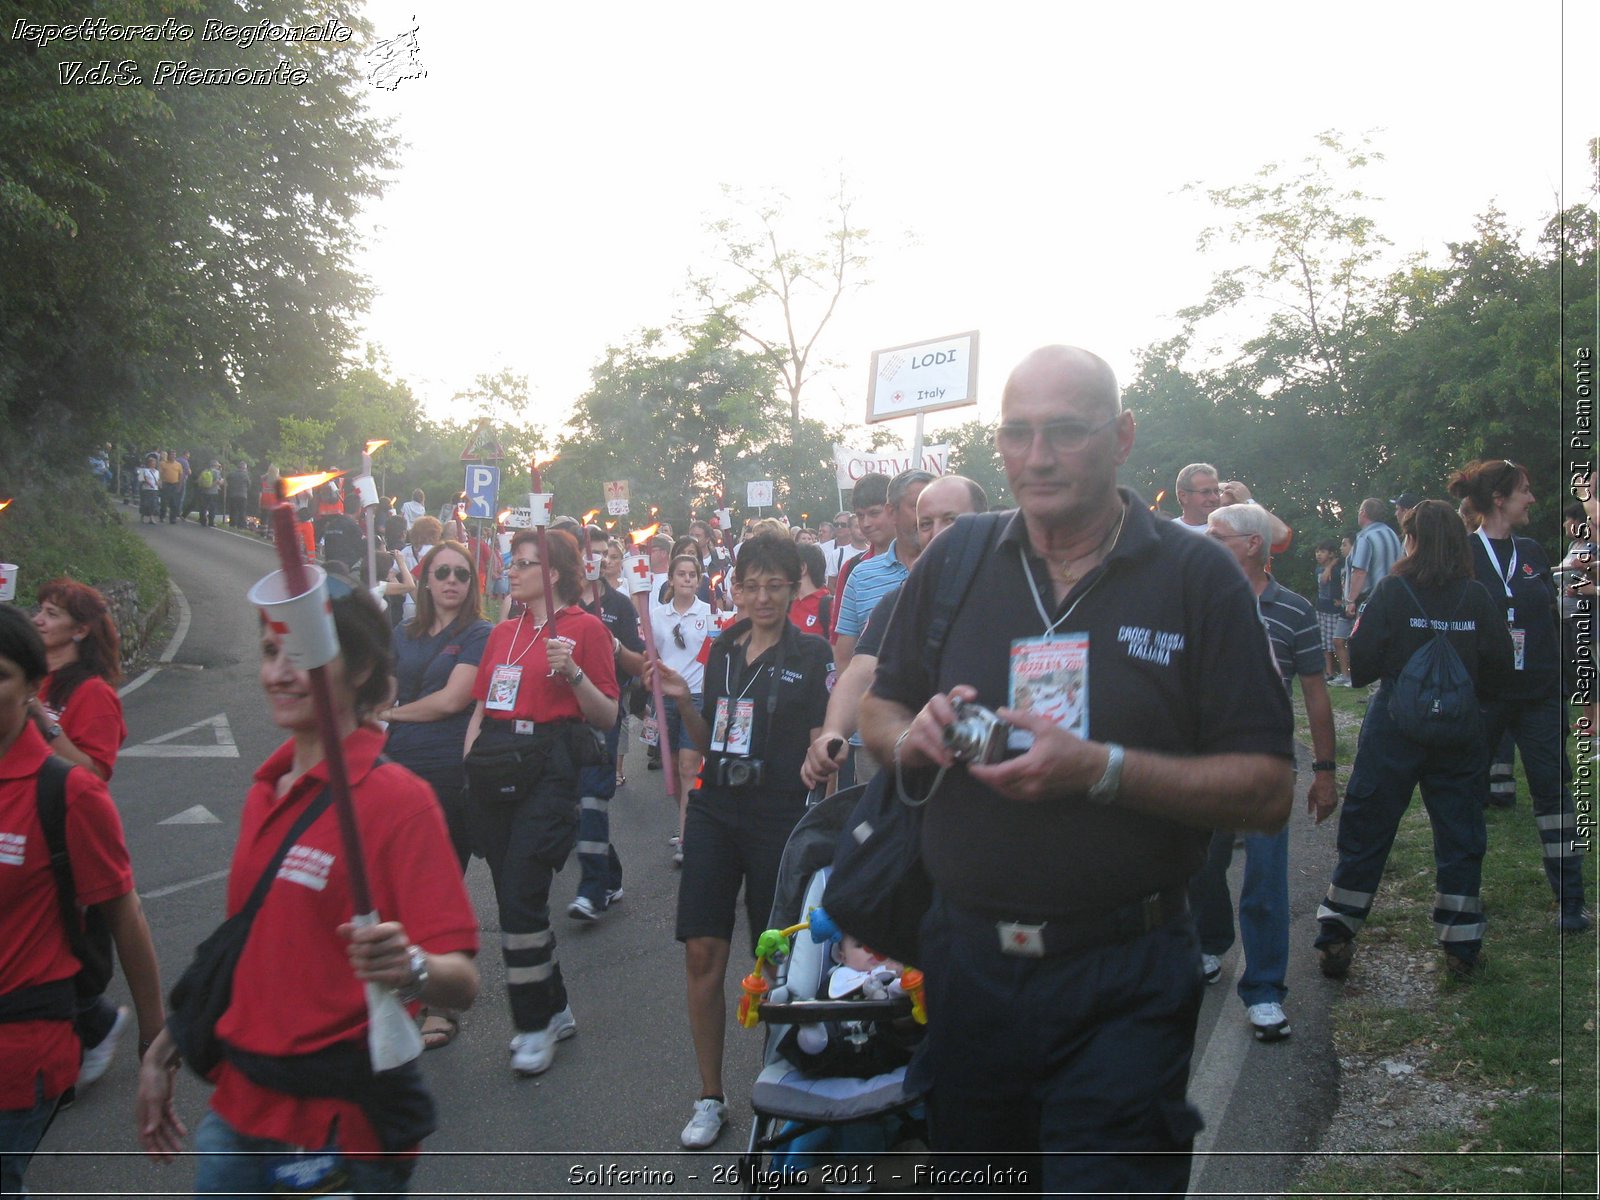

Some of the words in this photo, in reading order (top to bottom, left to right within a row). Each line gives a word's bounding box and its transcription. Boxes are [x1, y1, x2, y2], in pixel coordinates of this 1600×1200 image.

[911, 349, 957, 370] LODI
[917, 387, 946, 401] Italy
[473, 468, 493, 494] P
[1450, 620, 1476, 631] ITALIANA
[1117, 625, 1152, 644] CROCE
[1154, 630, 1185, 651] ROSSA
[1127, 641, 1171, 666] ITALIANA
